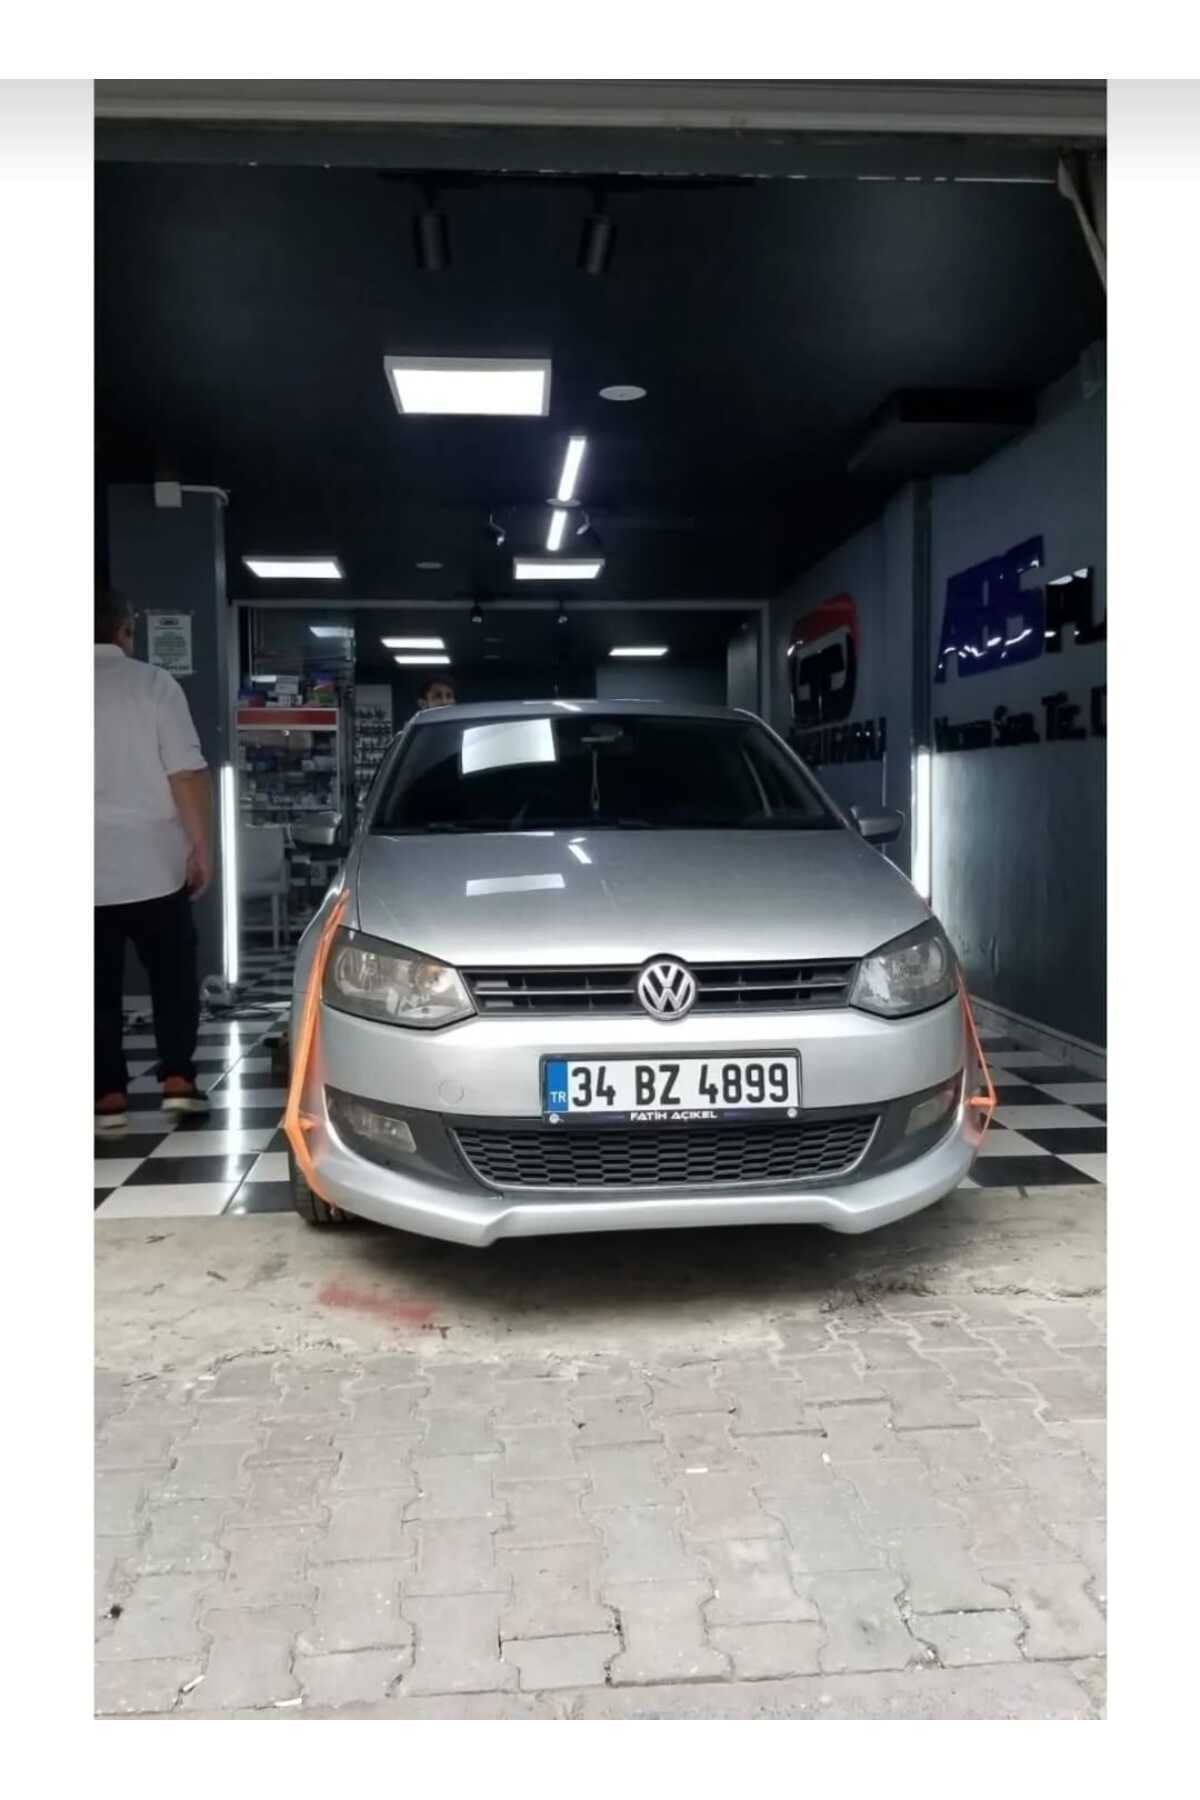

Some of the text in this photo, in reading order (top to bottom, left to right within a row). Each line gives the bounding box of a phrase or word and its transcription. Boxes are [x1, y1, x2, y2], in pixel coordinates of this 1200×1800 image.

[551, 1090, 567, 1104] TR
[571, 1062, 789, 1107] 34 BZ 4899
